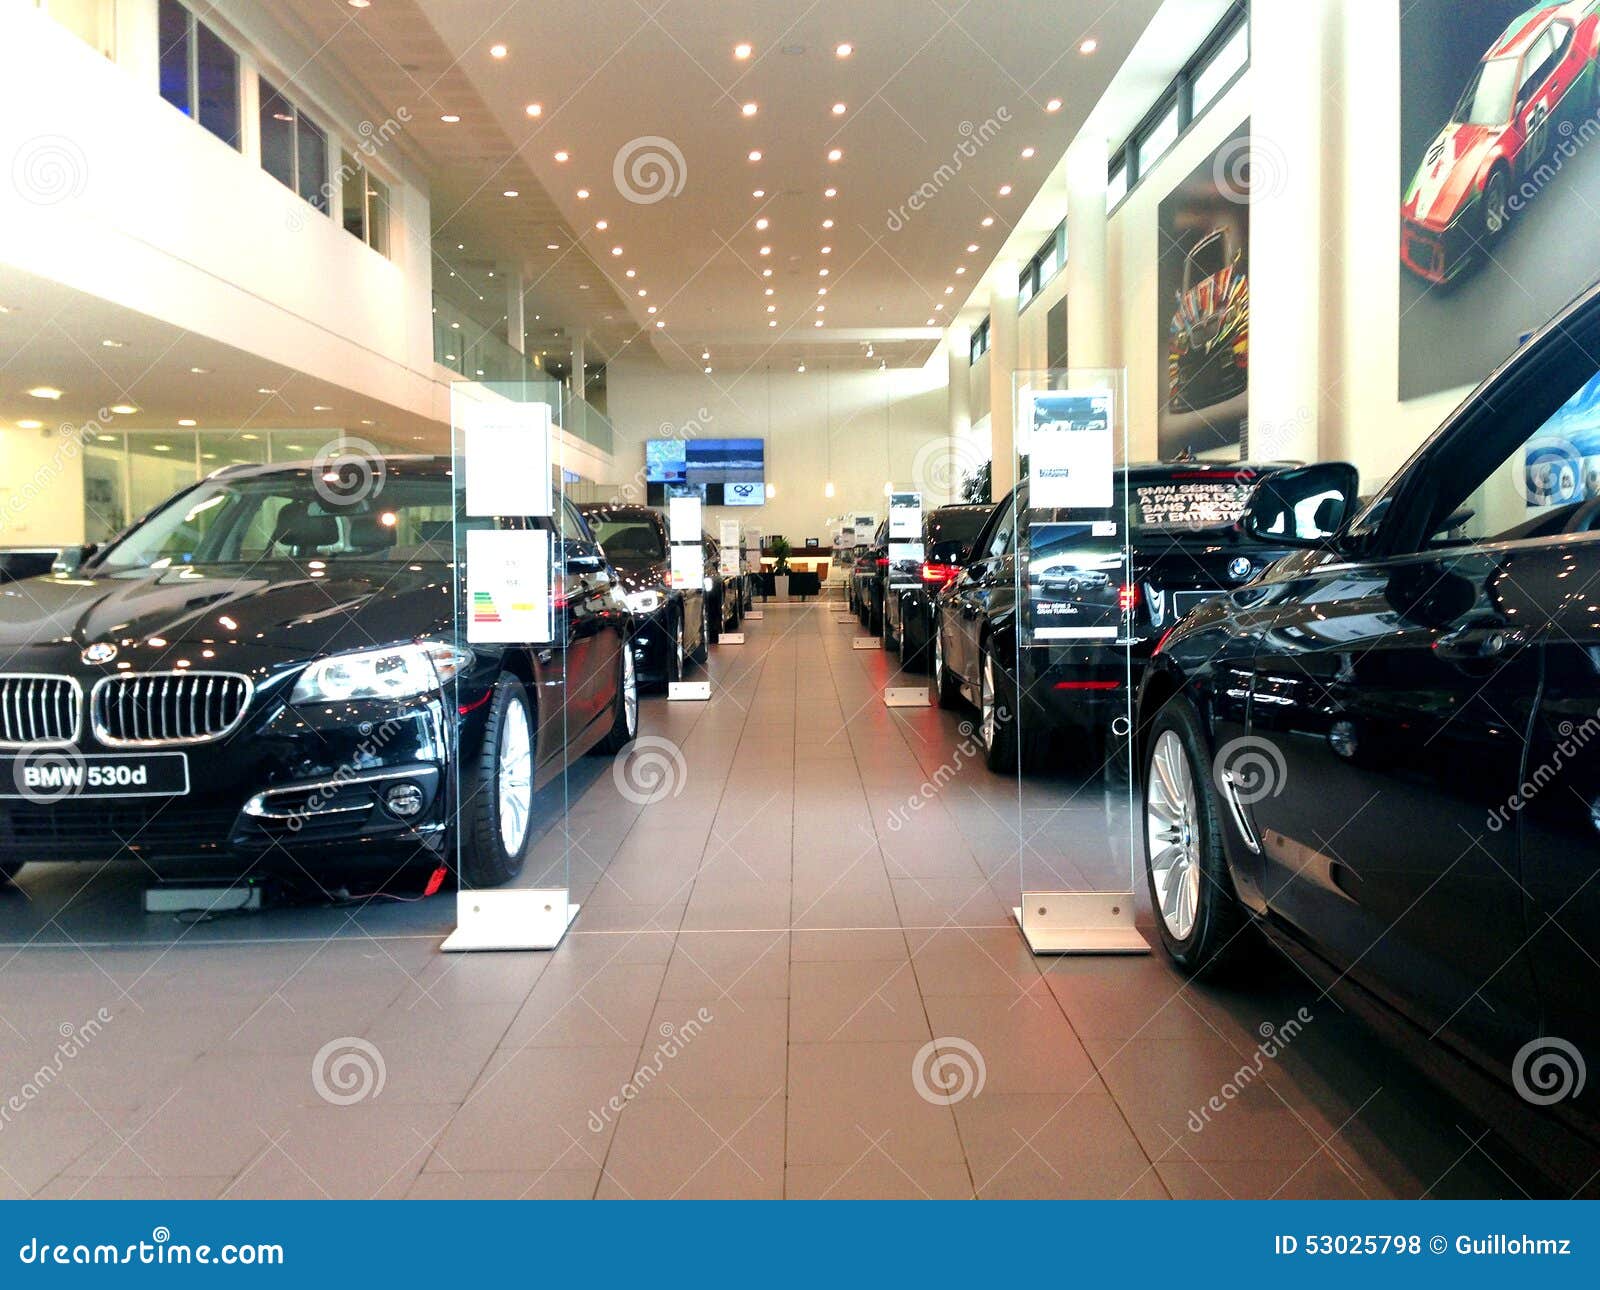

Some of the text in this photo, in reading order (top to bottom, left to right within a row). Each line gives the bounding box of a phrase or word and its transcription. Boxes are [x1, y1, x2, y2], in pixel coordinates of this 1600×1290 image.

[1155, 493, 1210, 502] PARTIR
[1142, 501, 1246, 514] SANS APPOR
[1144, 514, 1164, 524] ET
[24, 765, 147, 787] BMW 530d
